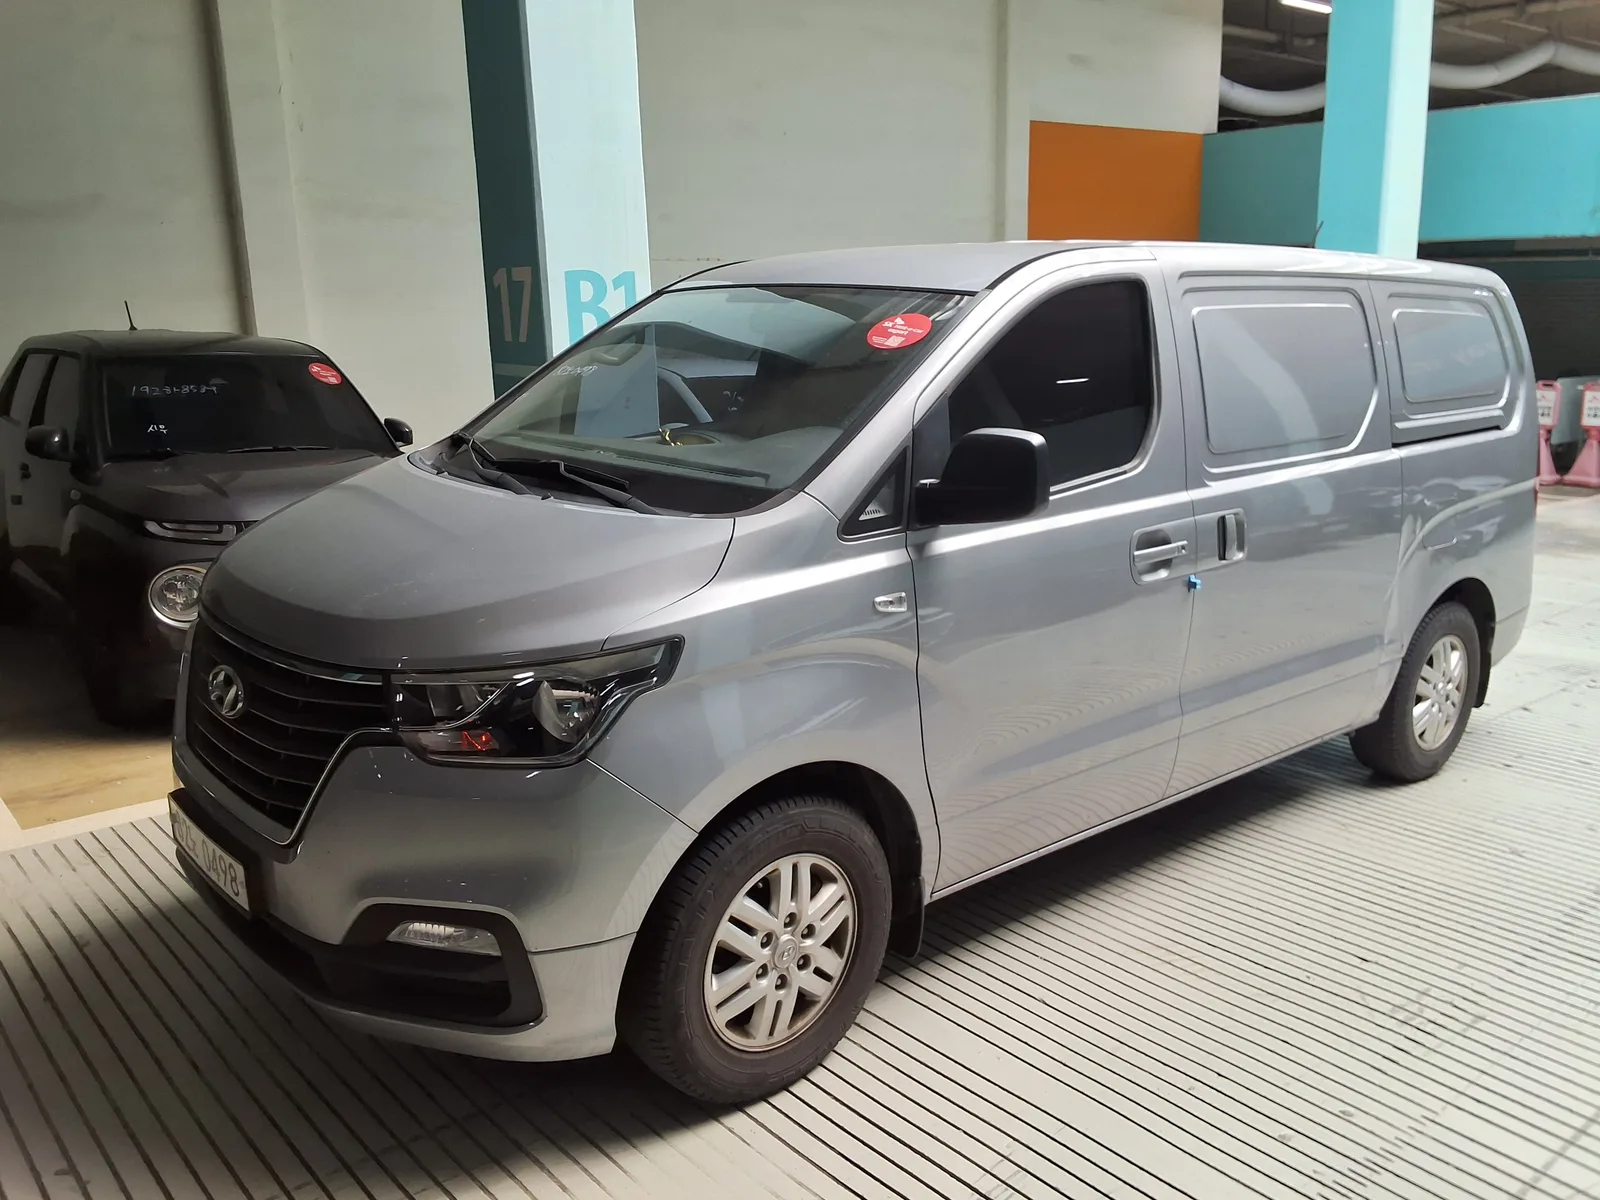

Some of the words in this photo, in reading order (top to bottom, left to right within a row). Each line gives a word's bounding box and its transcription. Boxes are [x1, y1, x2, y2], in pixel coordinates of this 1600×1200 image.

[492, 266, 532, 343] 17
[564, 269, 637, 346] B1
[201, 838, 240, 898] 0498
